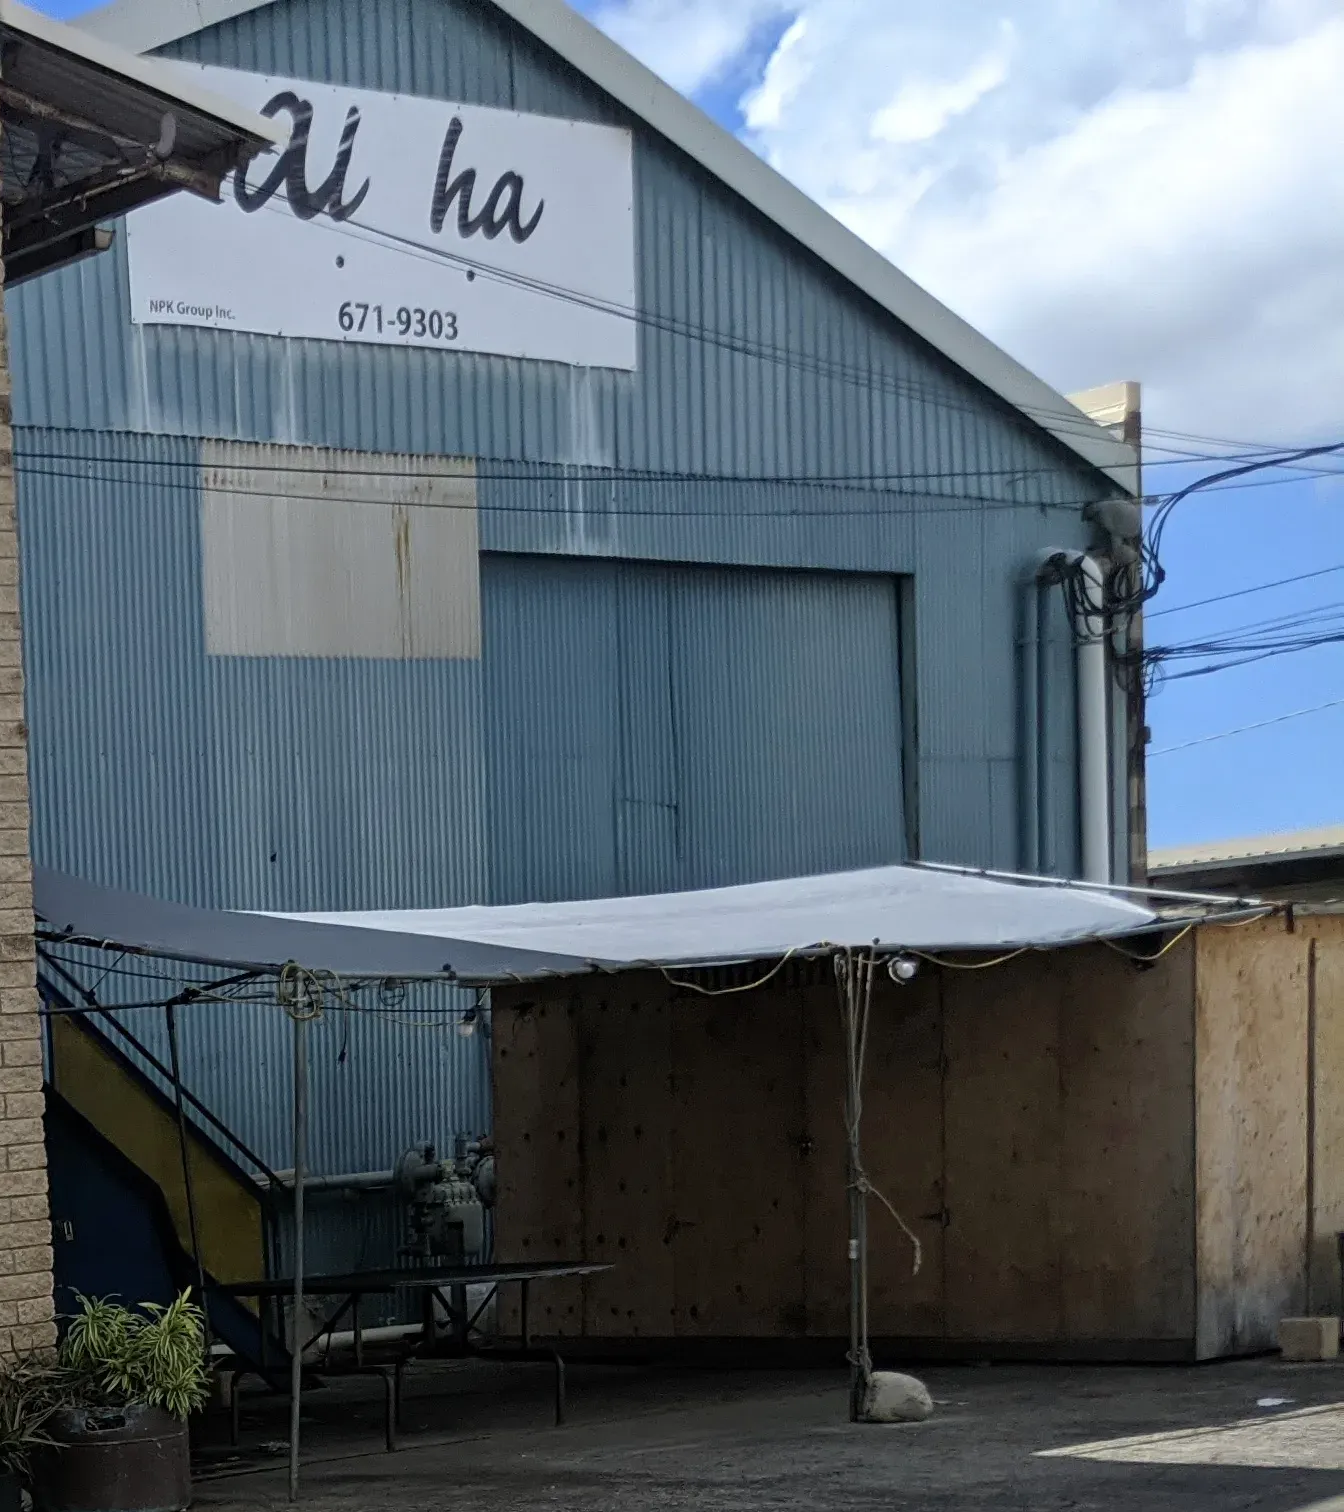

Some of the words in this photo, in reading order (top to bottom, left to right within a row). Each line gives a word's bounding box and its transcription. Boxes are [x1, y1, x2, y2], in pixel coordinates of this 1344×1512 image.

[429, 116, 545, 244] ha
[149, 299, 174, 314] NPK
[176, 301, 213, 320] Group
[215, 304, 236, 320] Inc.
[338, 301, 459, 341] 671-9303
